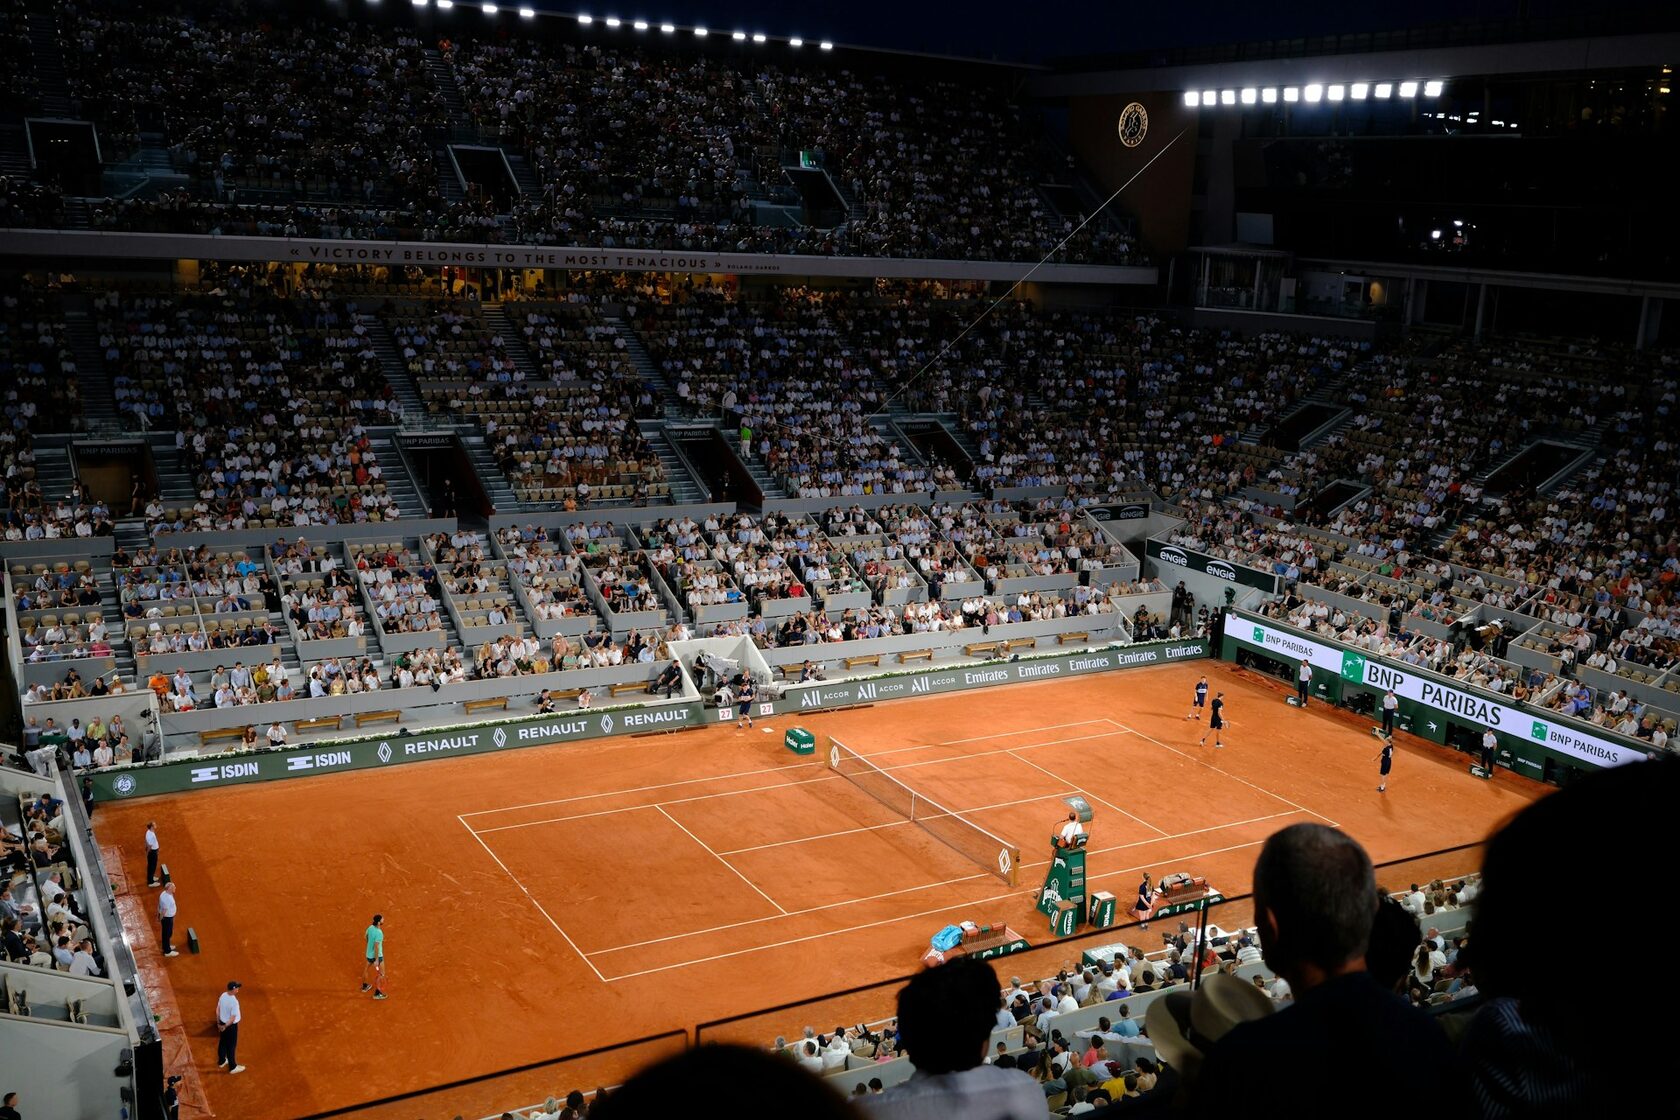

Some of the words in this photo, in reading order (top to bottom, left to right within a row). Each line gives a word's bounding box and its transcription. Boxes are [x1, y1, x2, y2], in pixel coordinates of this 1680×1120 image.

[309, 246, 393, 259] VICTORY
[404, 250, 485, 263] BELONGS
[495, 252, 515, 263] TO
[524, 253, 556, 265] THE
[565, 255, 608, 266] MOST
[616, 256, 706, 269] TENACIOUS
[1165, 644, 1203, 659] Emirates
[1265, 634, 1282, 646] BNP
[1282, 640, 1313, 657] PARIBAS
[1069, 657, 1110, 671] Emirates
[1118, 651, 1157, 665] Emirates
[965, 670, 1009, 685] Emirates
[1018, 663, 1060, 678] Emirates
[879, 684, 904, 693] ACCOR
[932, 677, 956, 686] ACCOR
[823, 691, 849, 700] ACCOR
[1368, 664, 1404, 691] BNP
[1421, 683, 1502, 726] PARIBAS
[719, 710, 731, 719] 27
[760, 704, 772, 714] 27
[624, 709, 689, 727] RENAULT
[518, 721, 588, 740] RENAULT
[405, 735, 479, 755] RENAULT
[1550, 731, 1573, 746] BNP
[1573, 739, 1618, 763] PARIBAS
[316, 751, 352, 767] ISDIN
[221, 762, 259, 779] ISDIN
